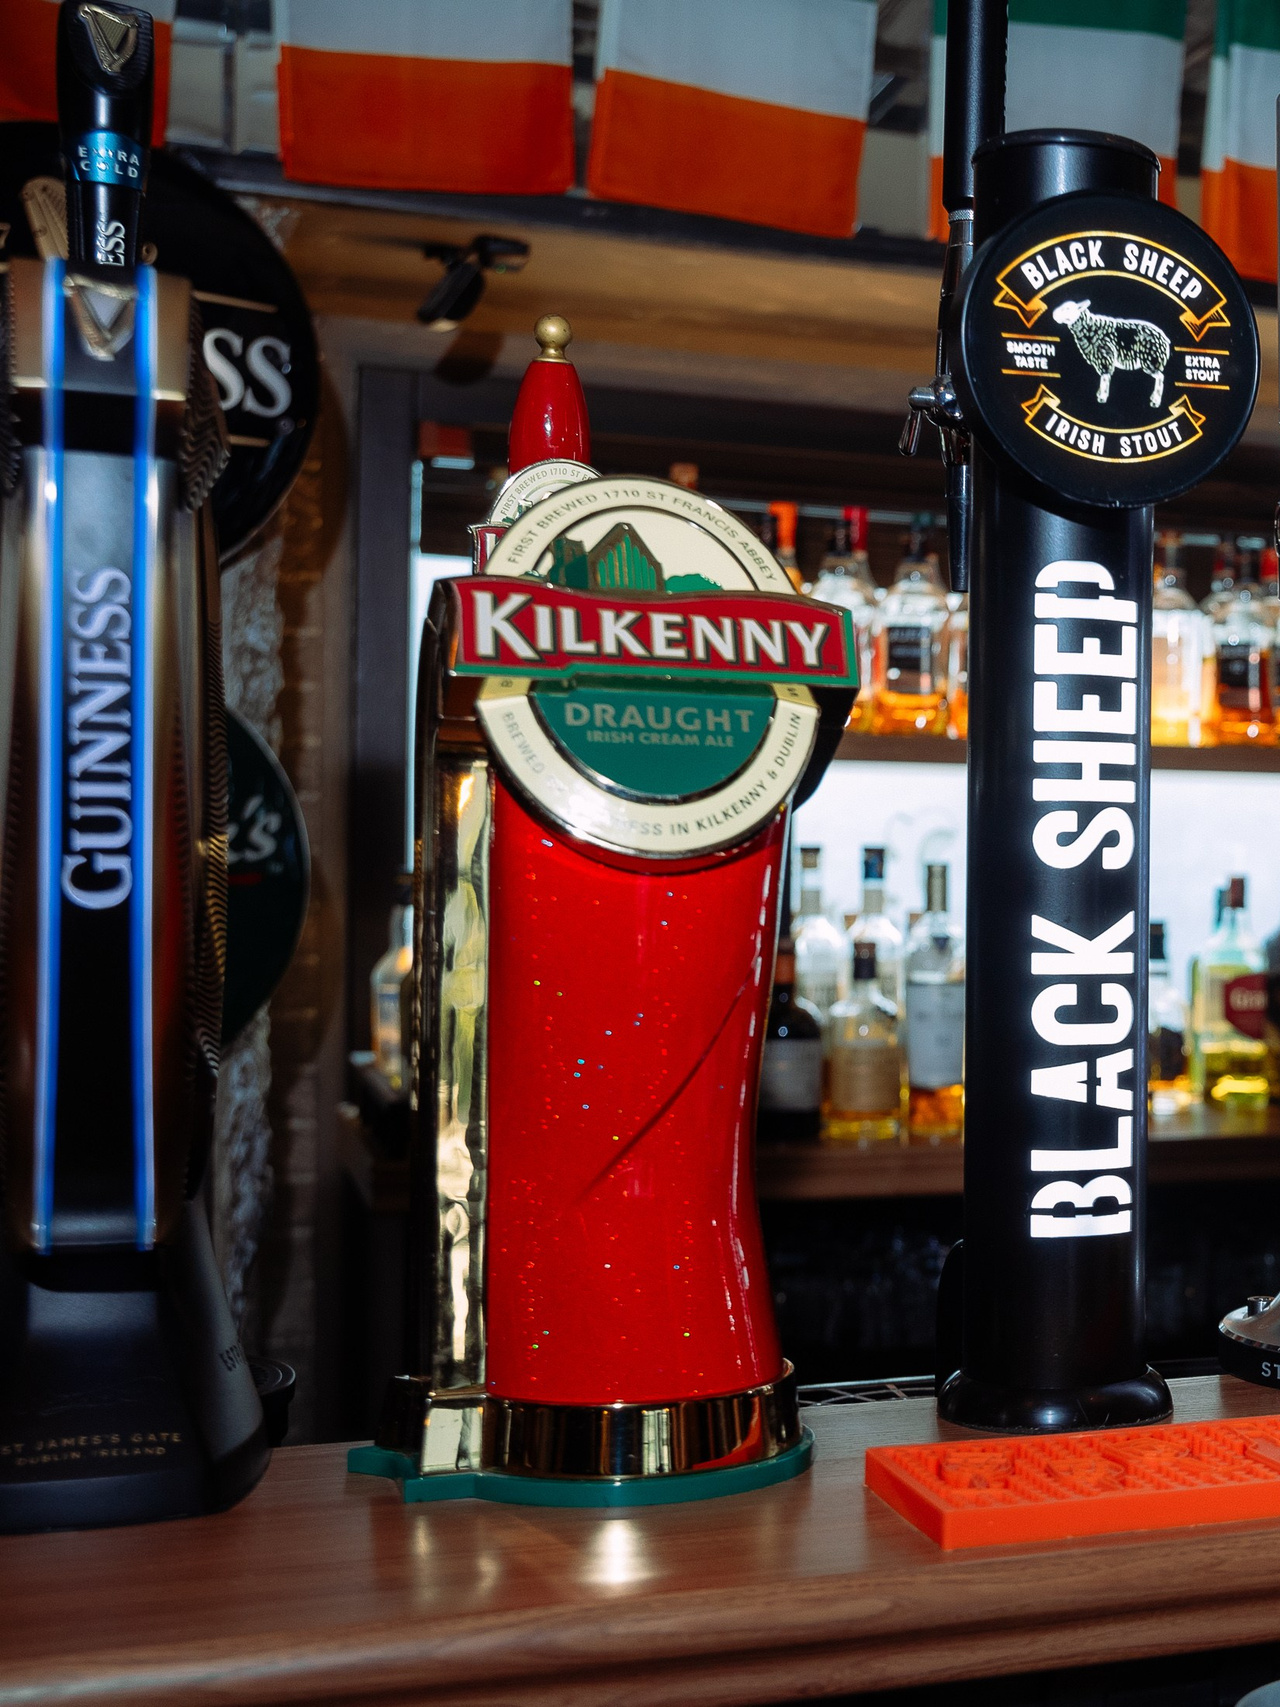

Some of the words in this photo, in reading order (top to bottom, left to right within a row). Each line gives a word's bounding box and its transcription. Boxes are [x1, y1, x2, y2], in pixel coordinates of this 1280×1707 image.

[1021, 240, 1105, 291] BLACK
[1123, 242, 1202, 300] SHEEP
[1006, 341, 1056, 357] SMOOTH
[1013, 355, 1049, 370] TASTE
[1185, 355, 1220, 370] EXTRA
[1185, 369, 1220, 383] STOUT
[1044, 413, 1105, 456] IRISH
[1120, 422, 1184, 458] STOUT
[500, 494, 517, 516] FIRST
[515, 470, 548, 495] BREWED
[508, 530, 538, 565] FIRST
[537, 494, 597, 529] BREWED
[604, 490, 640, 499] 1710
[646, 491, 668, 501] ST
[673, 497, 739, 540] FRANCIS
[738, 541, 777, 582] ABBEY
[471, 590, 829, 667] KILKENNY
[564, 702, 754, 733] DRAUGHT
[1032, 559, 1138, 870] SHEEP
[62, 567, 133, 909] GUINNESS
[587, 730, 635, 744] IRISH
[639, 732, 700, 747] CREAM
[705, 735, 735, 748] ALE
[503, 711, 546, 774] BREWED
[671, 822, 689, 835] IN
[696, 780, 768, 831] KILKENNY
[774, 713, 801, 767] DUBLIN
[1030, 910, 1135, 1239] BLACK
[129, 1432, 183, 1444] GATE
